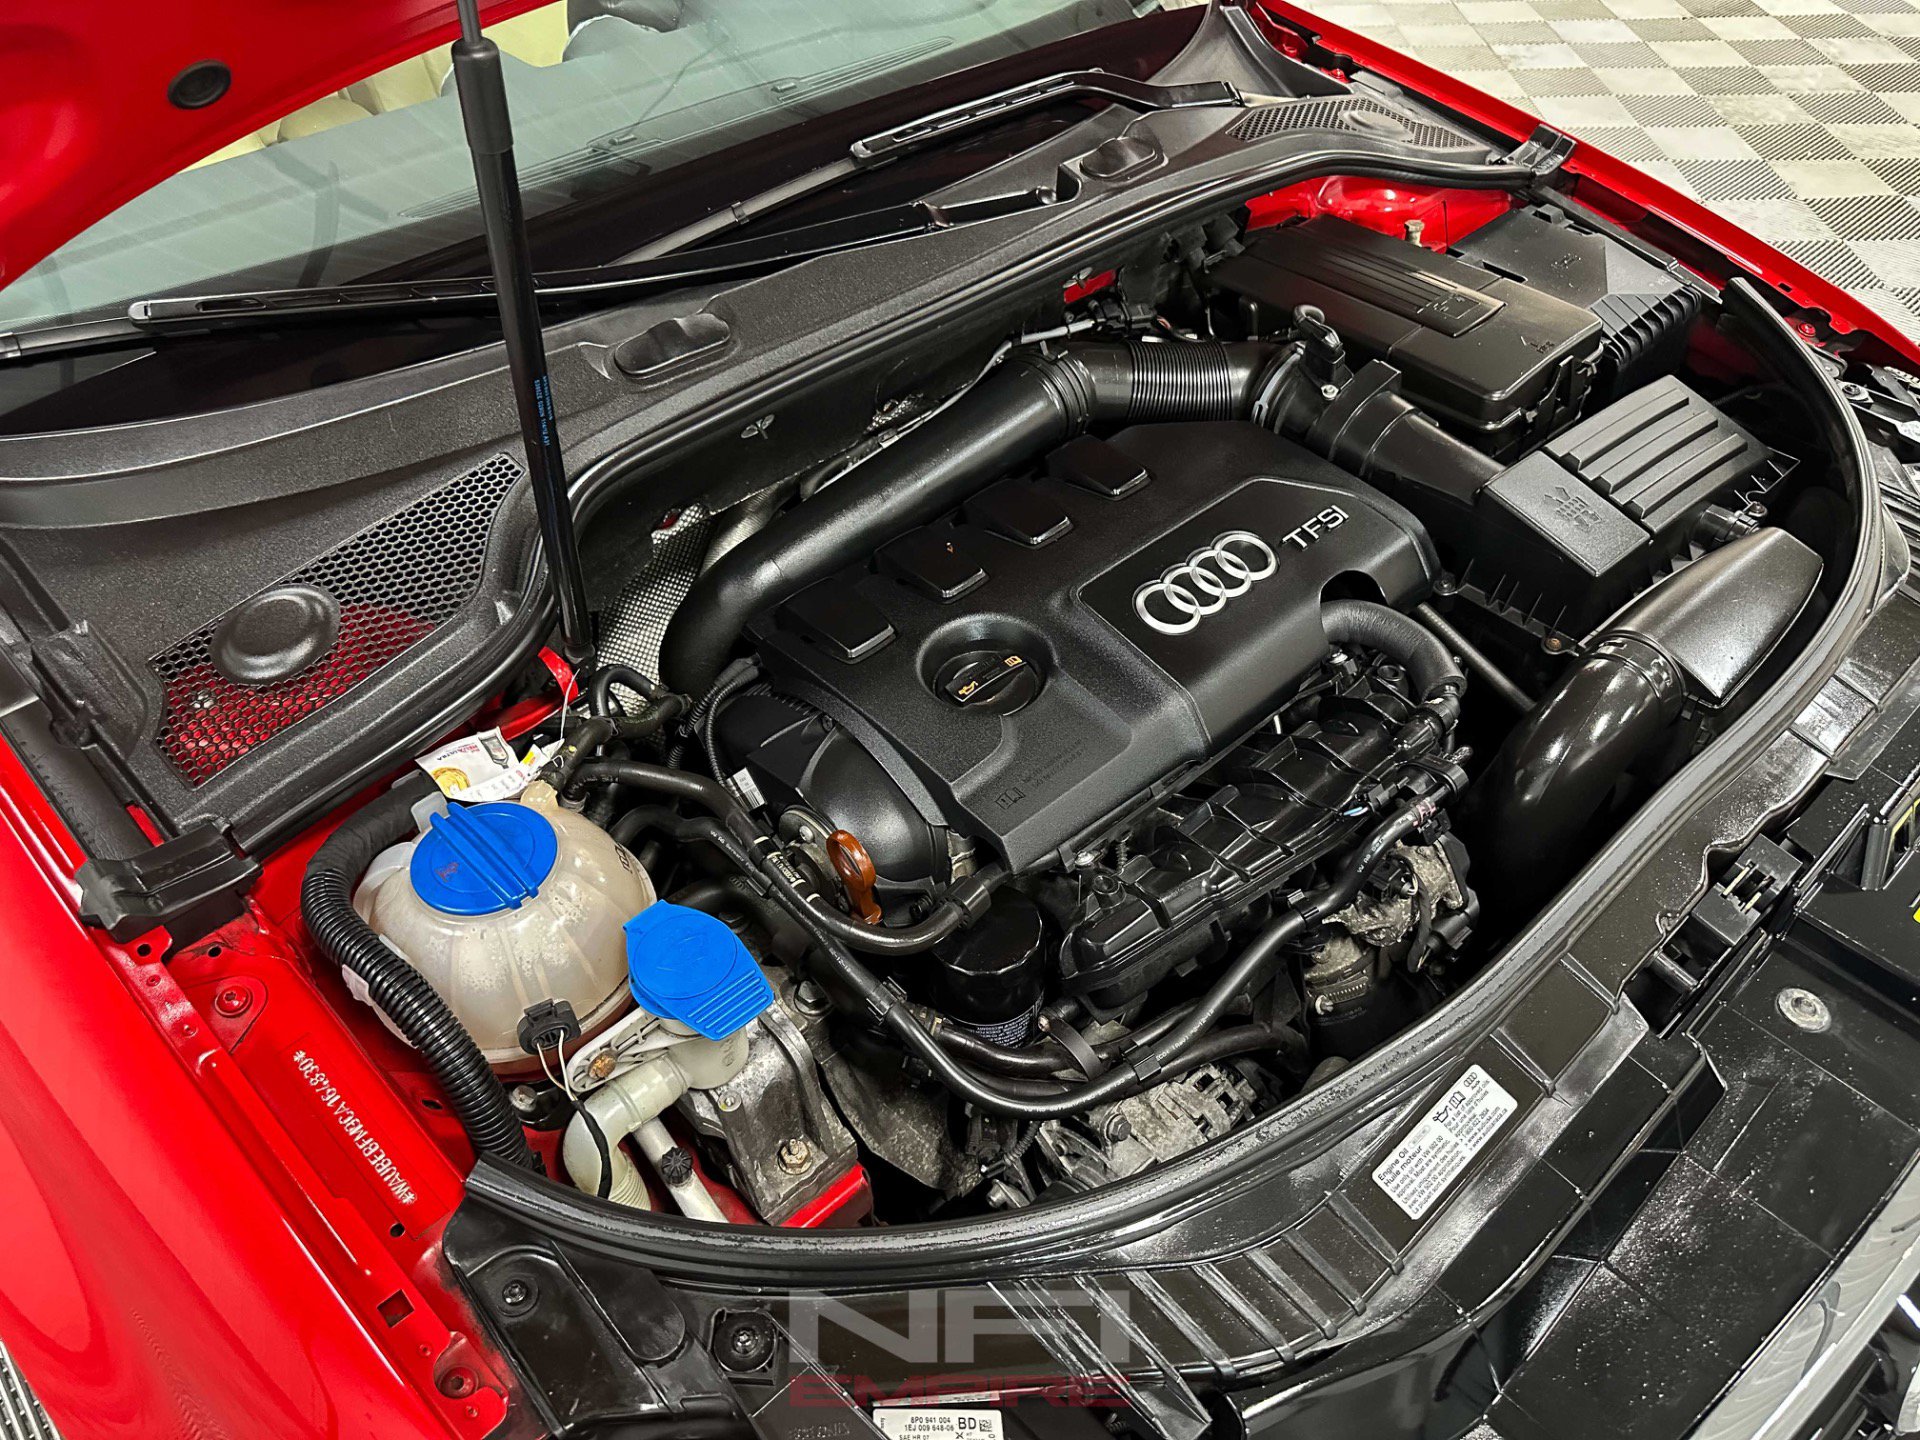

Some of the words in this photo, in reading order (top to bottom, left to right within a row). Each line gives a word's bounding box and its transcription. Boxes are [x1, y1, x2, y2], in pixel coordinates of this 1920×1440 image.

[1282, 504, 1350, 549] TFSI
[1377, 1158, 1400, 1181] Engine
[1398, 1147, 1409, 1159] Oil
[1383, 1169, 1401, 1187] Huile
[1400, 1145, 1422, 1171] moteur
[1414, 1157, 1424, 1168] with
[957, 1416, 977, 1430] BD
